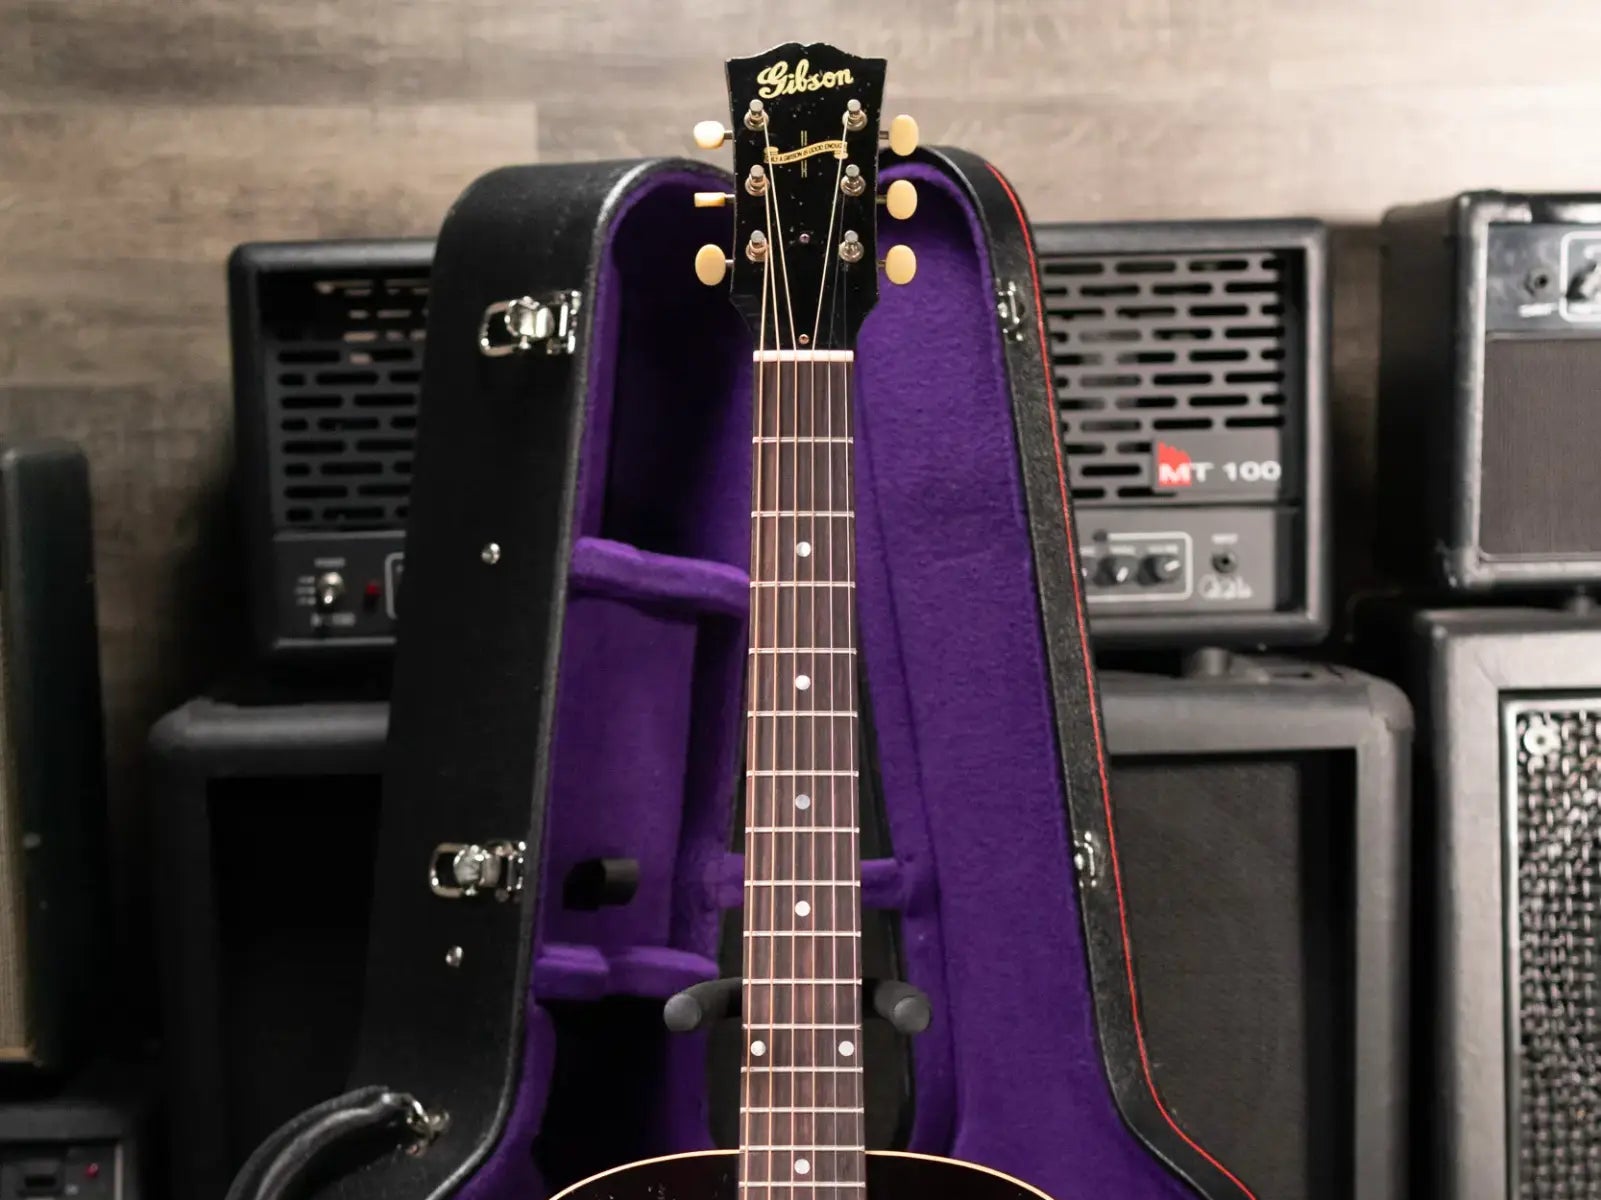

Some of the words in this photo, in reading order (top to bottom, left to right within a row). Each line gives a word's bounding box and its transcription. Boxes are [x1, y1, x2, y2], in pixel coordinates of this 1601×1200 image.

[757, 58, 854, 99] Gibson
[1158, 461, 1214, 483] MT
[1222, 460, 1282, 482] 100
